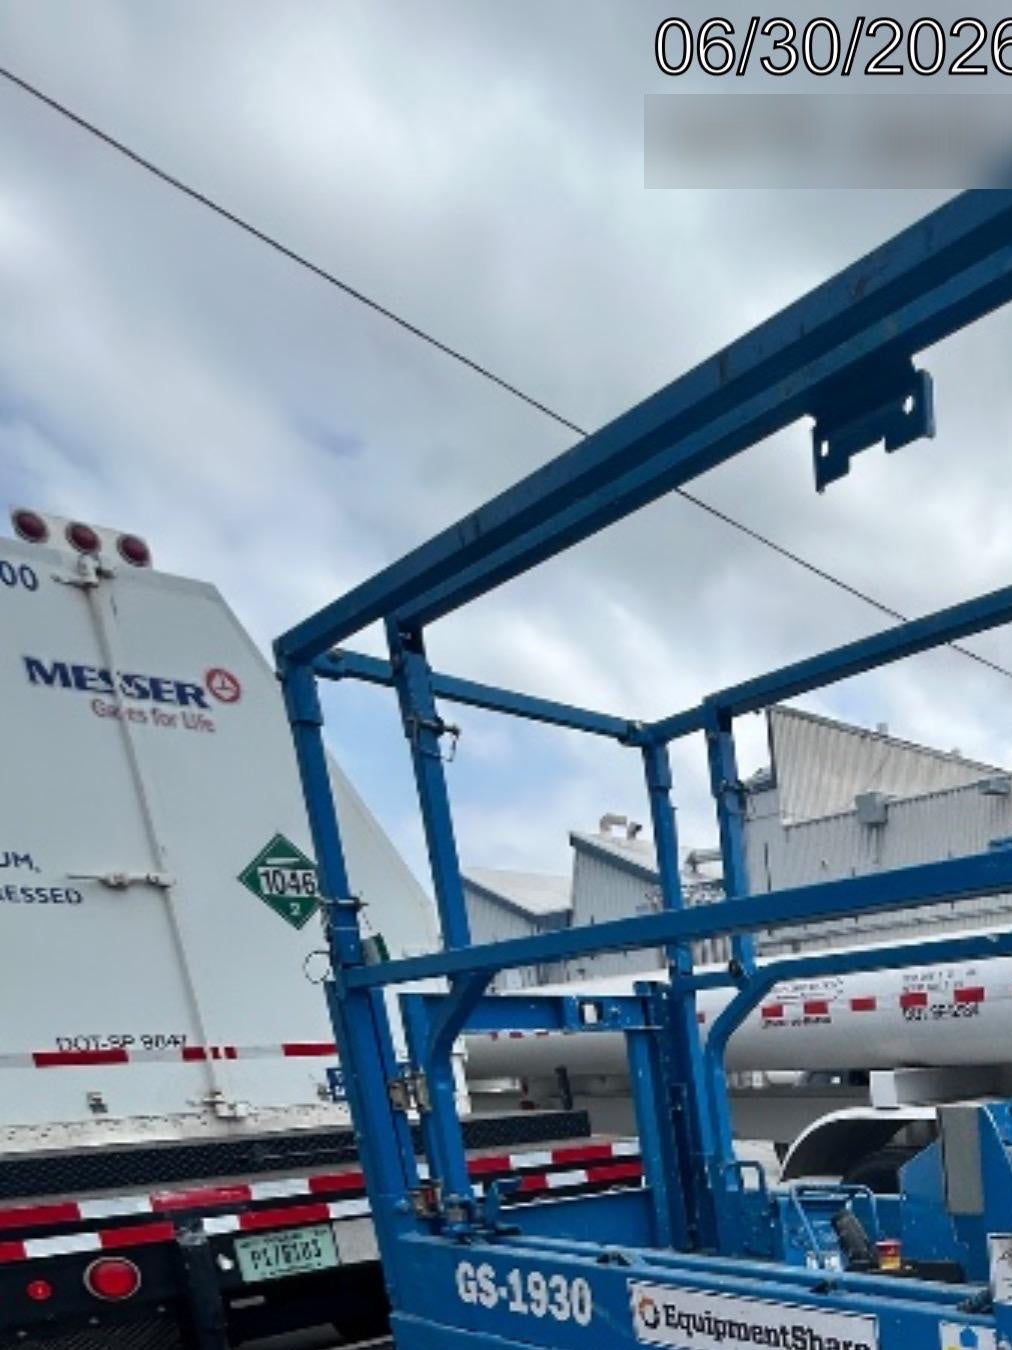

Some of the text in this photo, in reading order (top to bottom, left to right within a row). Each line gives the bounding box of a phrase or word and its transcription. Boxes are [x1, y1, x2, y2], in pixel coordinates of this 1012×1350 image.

[23, 656, 209, 710] MESSER
[0, 884, 83, 905] ESSED
[455, 1260, 593, 1327] GS-1930
